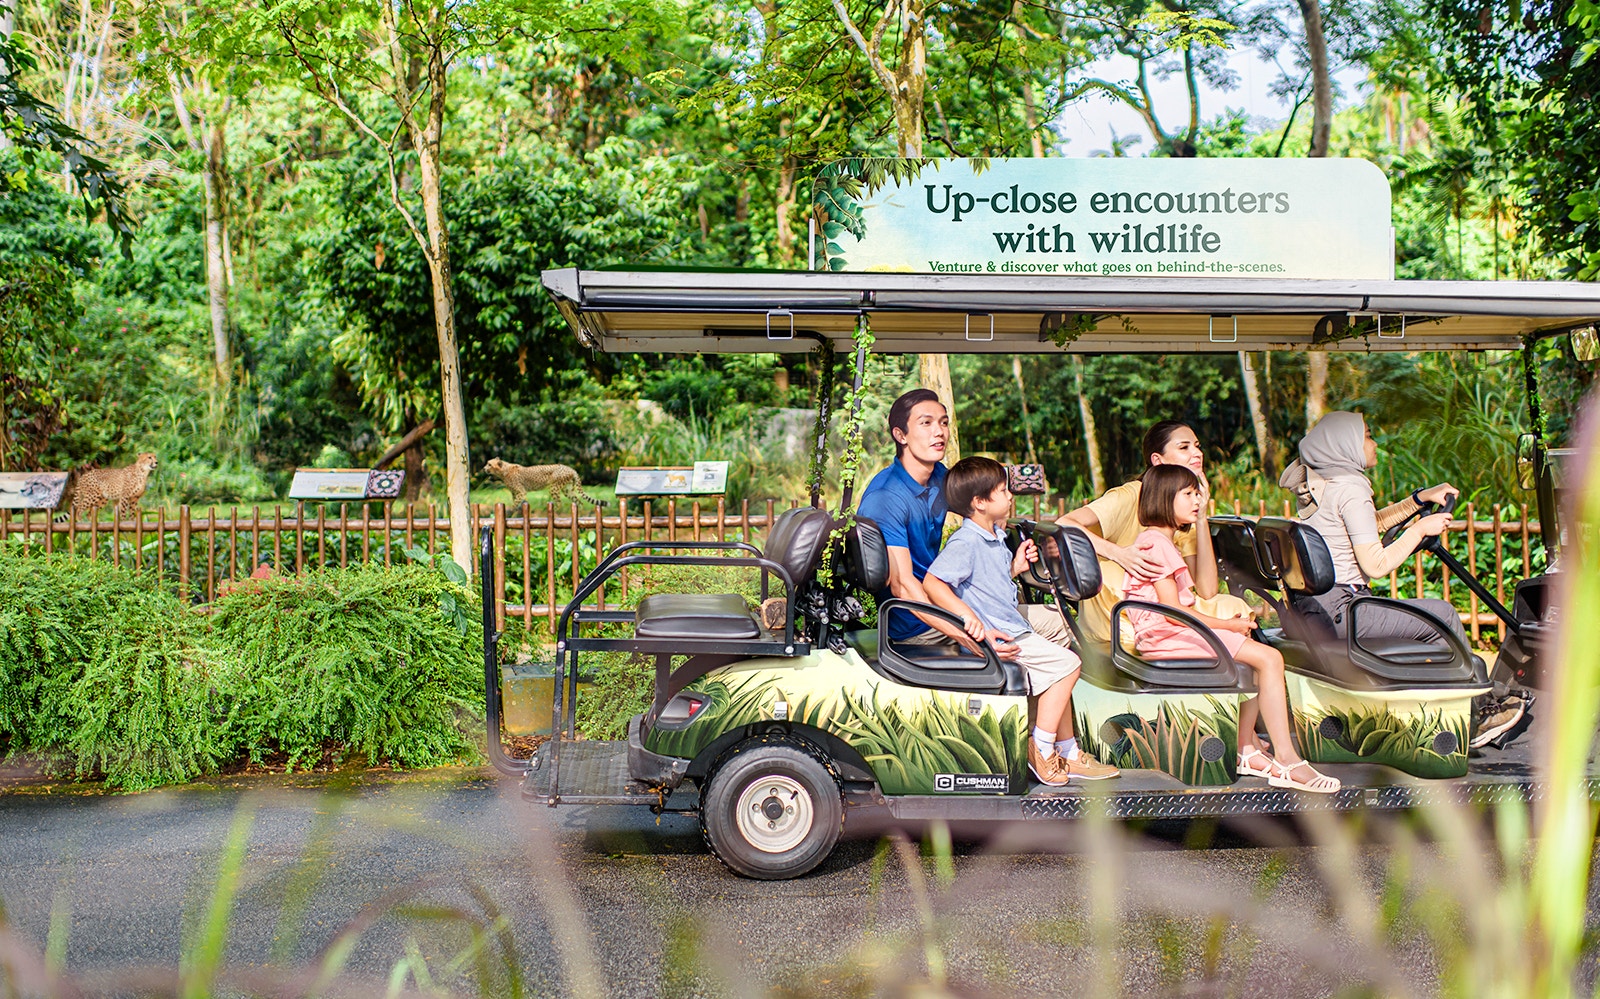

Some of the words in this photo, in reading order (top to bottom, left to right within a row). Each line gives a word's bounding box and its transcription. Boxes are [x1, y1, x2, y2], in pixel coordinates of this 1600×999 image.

[924, 184, 1077, 222] Up-close
[1090, 187, 1290, 214] encounters
[992, 223, 1076, 253] with
[1088, 223, 1221, 254] wildlife
[928, 260, 983, 273] Venture
[986, 261, 997, 273] &
[1000, 260, 1060, 273] discover
[1063, 260, 1099, 273] what
[1102, 263, 1132, 276] goes
[1135, 263, 1153, 273] on
[1157, 260, 1287, 273] behind-the-scenes.
[956, 777, 1005, 785] CUSHMAN
